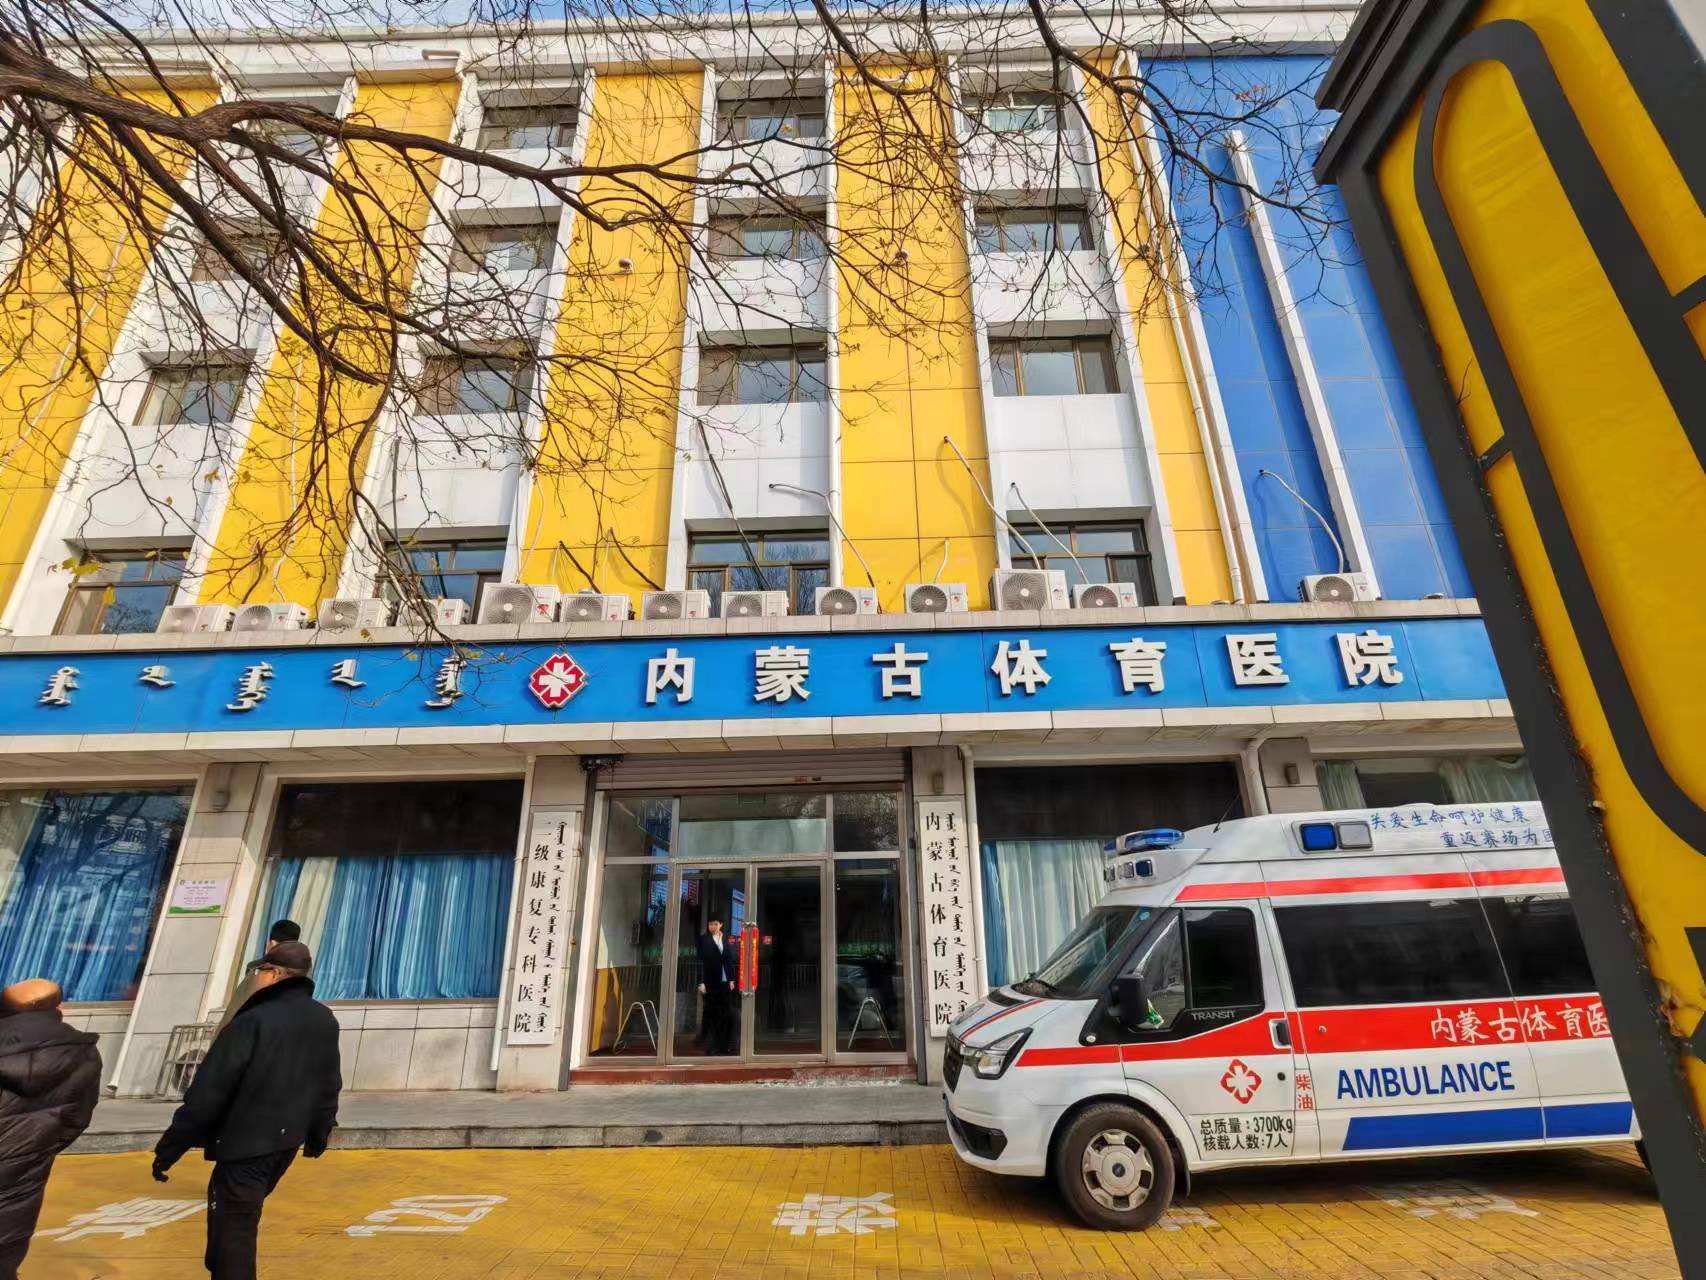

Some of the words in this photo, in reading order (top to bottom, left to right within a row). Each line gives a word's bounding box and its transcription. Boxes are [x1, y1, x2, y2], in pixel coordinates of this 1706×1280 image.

[645, 629, 1404, 704] 内蒙古体育医院
[513, 821, 552, 1033] 二级康复专科医院
[926, 811, 952, 1025] 内蒙古体育医院
[1191, 1009, 1237, 1021] TRANSIT
[1430, 1001, 1611, 1044] 内蒙古体育医
[1295, 1073, 1314, 1110] 柴油
[1337, 1060, 1516, 1100] AMBULANCE
[343, 1194, 508, 1237] 120
